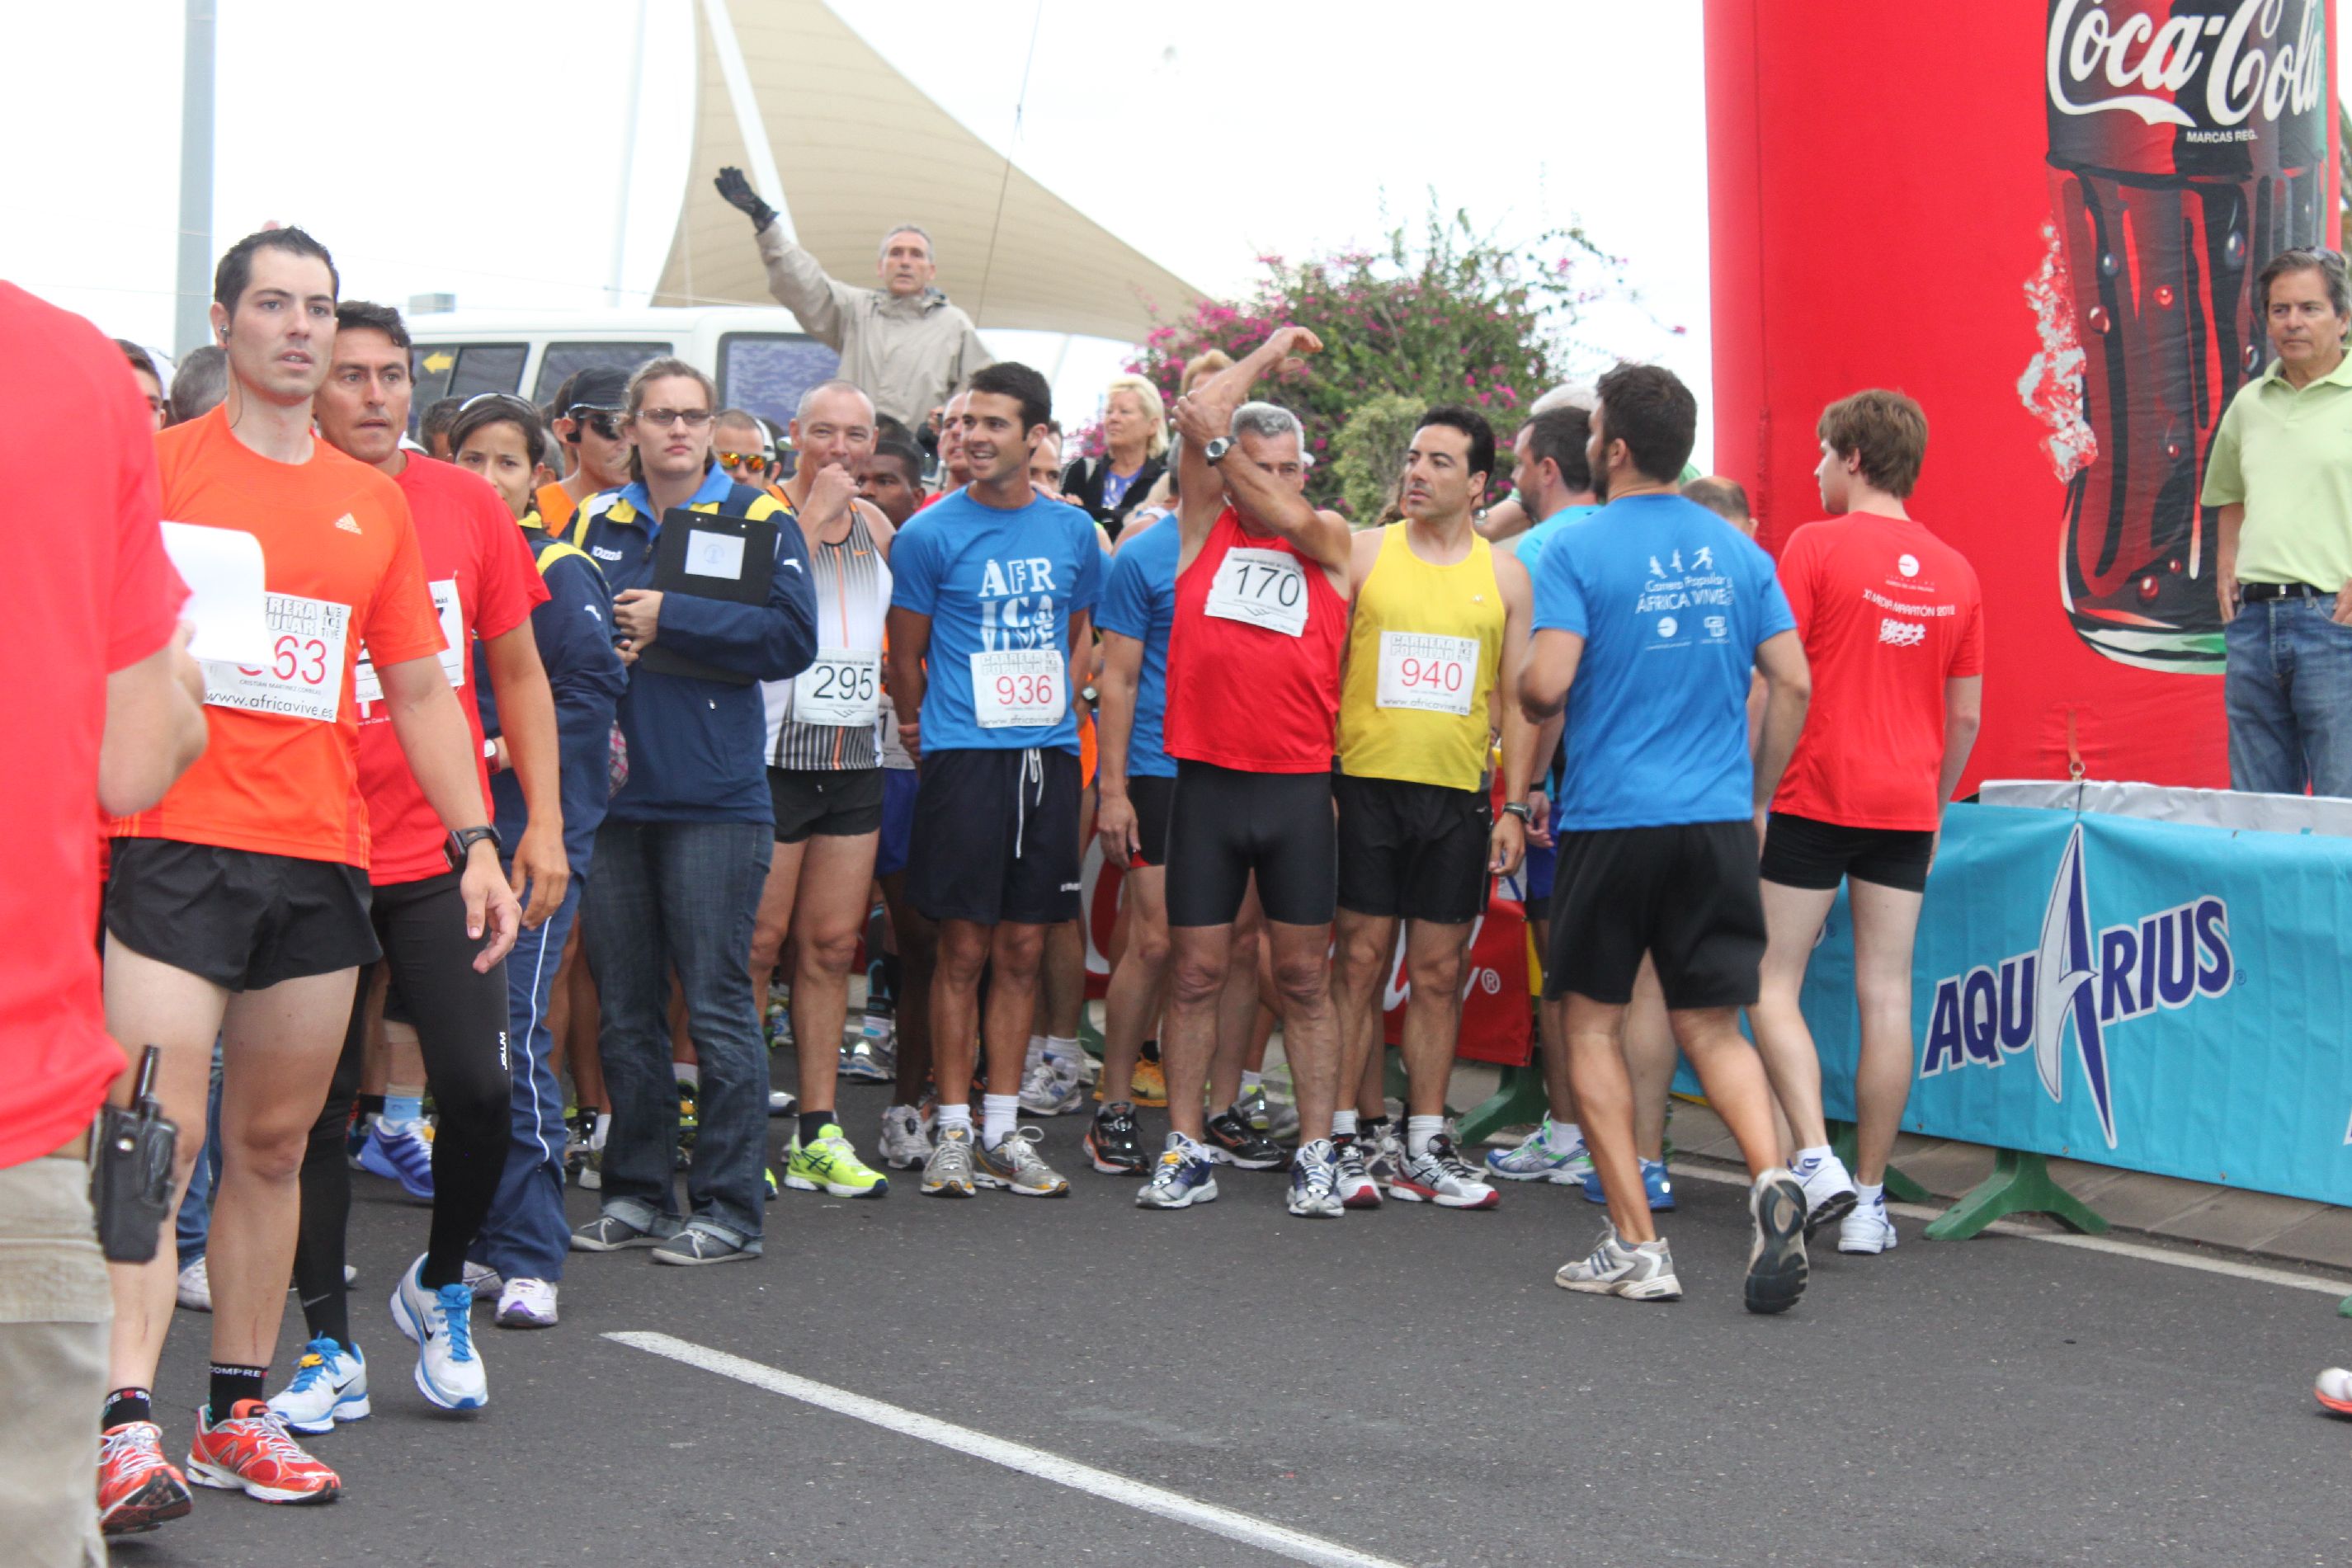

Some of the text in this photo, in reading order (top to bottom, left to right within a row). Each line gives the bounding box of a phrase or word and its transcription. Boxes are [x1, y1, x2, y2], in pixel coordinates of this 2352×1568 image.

[2047, 0, 2321, 128] Coca-Cola
[2186, 129, 2258, 143] MARCAS REG.
[978, 558, 1056, 597] AFR
[1237, 564, 1299, 607] 170
[979, 595, 1053, 627] ICA
[1635, 593, 1691, 614] ÁFRICA
[1936, 605, 1955, 616] 2012
[266, 612, 316, 636] ULAR
[813, 666, 873, 700] 295
[997, 675, 1052, 704] 936
[1402, 658, 1463, 691] 940
[205, 692, 333, 718] www.africavive.es
[1920, 822, 2234, 1149] AQUARIUS
